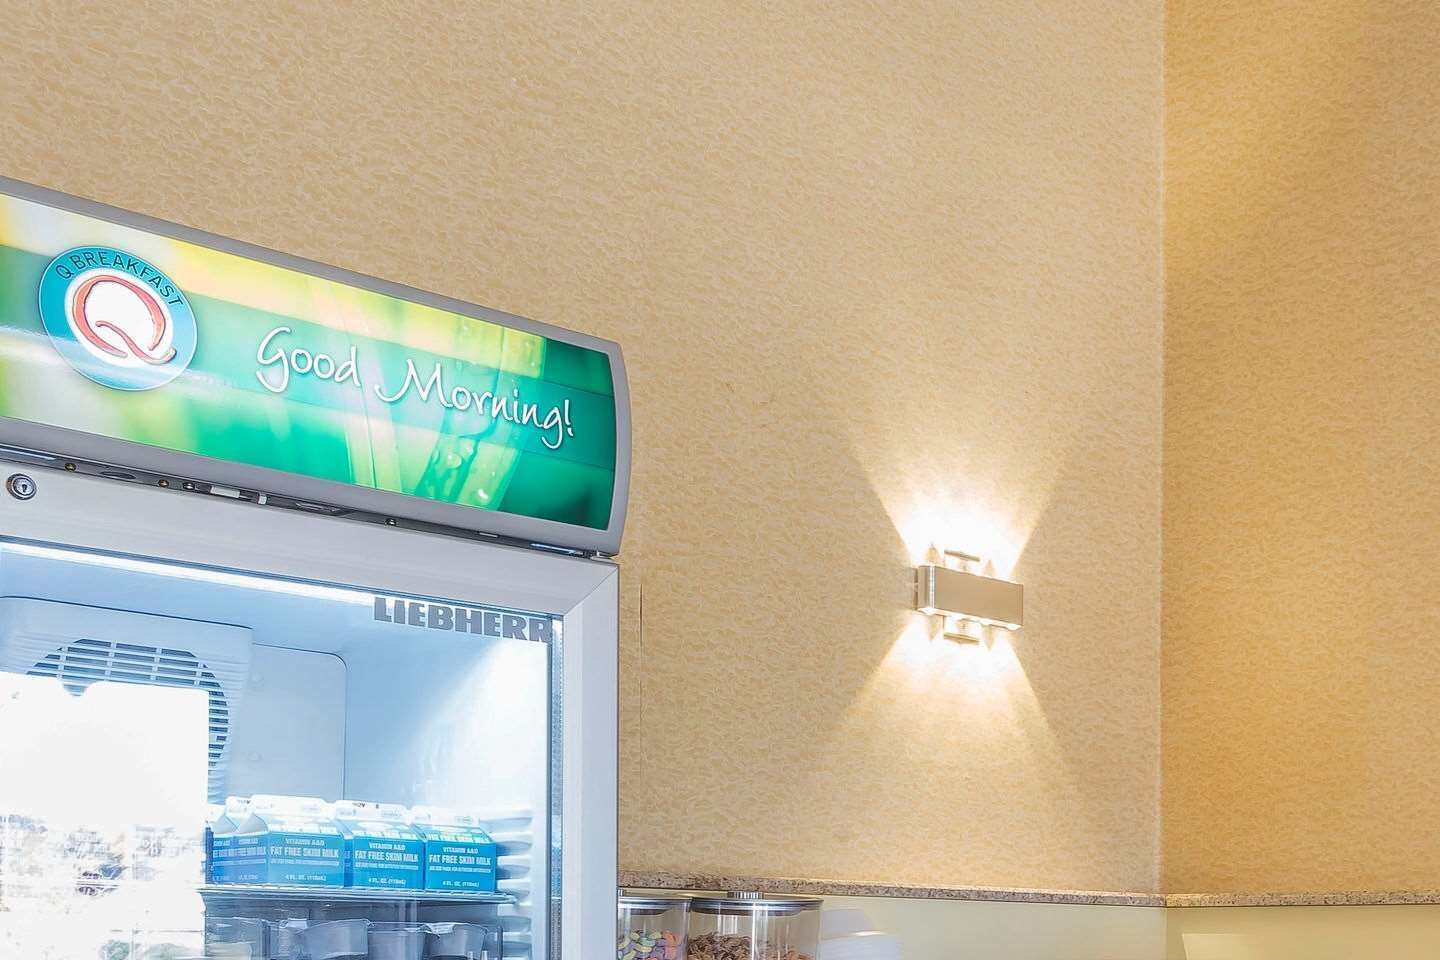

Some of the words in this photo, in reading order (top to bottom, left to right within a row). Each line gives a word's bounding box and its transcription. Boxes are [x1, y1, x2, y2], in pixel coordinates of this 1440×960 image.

[55, 264, 74, 279] Q
[70, 251, 184, 306] BREAKFAST
[72, 274, 177, 365] Q
[256, 326, 361, 393] Good
[374, 358, 574, 449] Morning!
[374, 596, 551, 643] LIEBHERR
[355, 850, 367, 859] FAT
[368, 851, 385, 860] FREE
[429, 854, 441, 863] FAT
[442, 855, 458, 864] FREE
